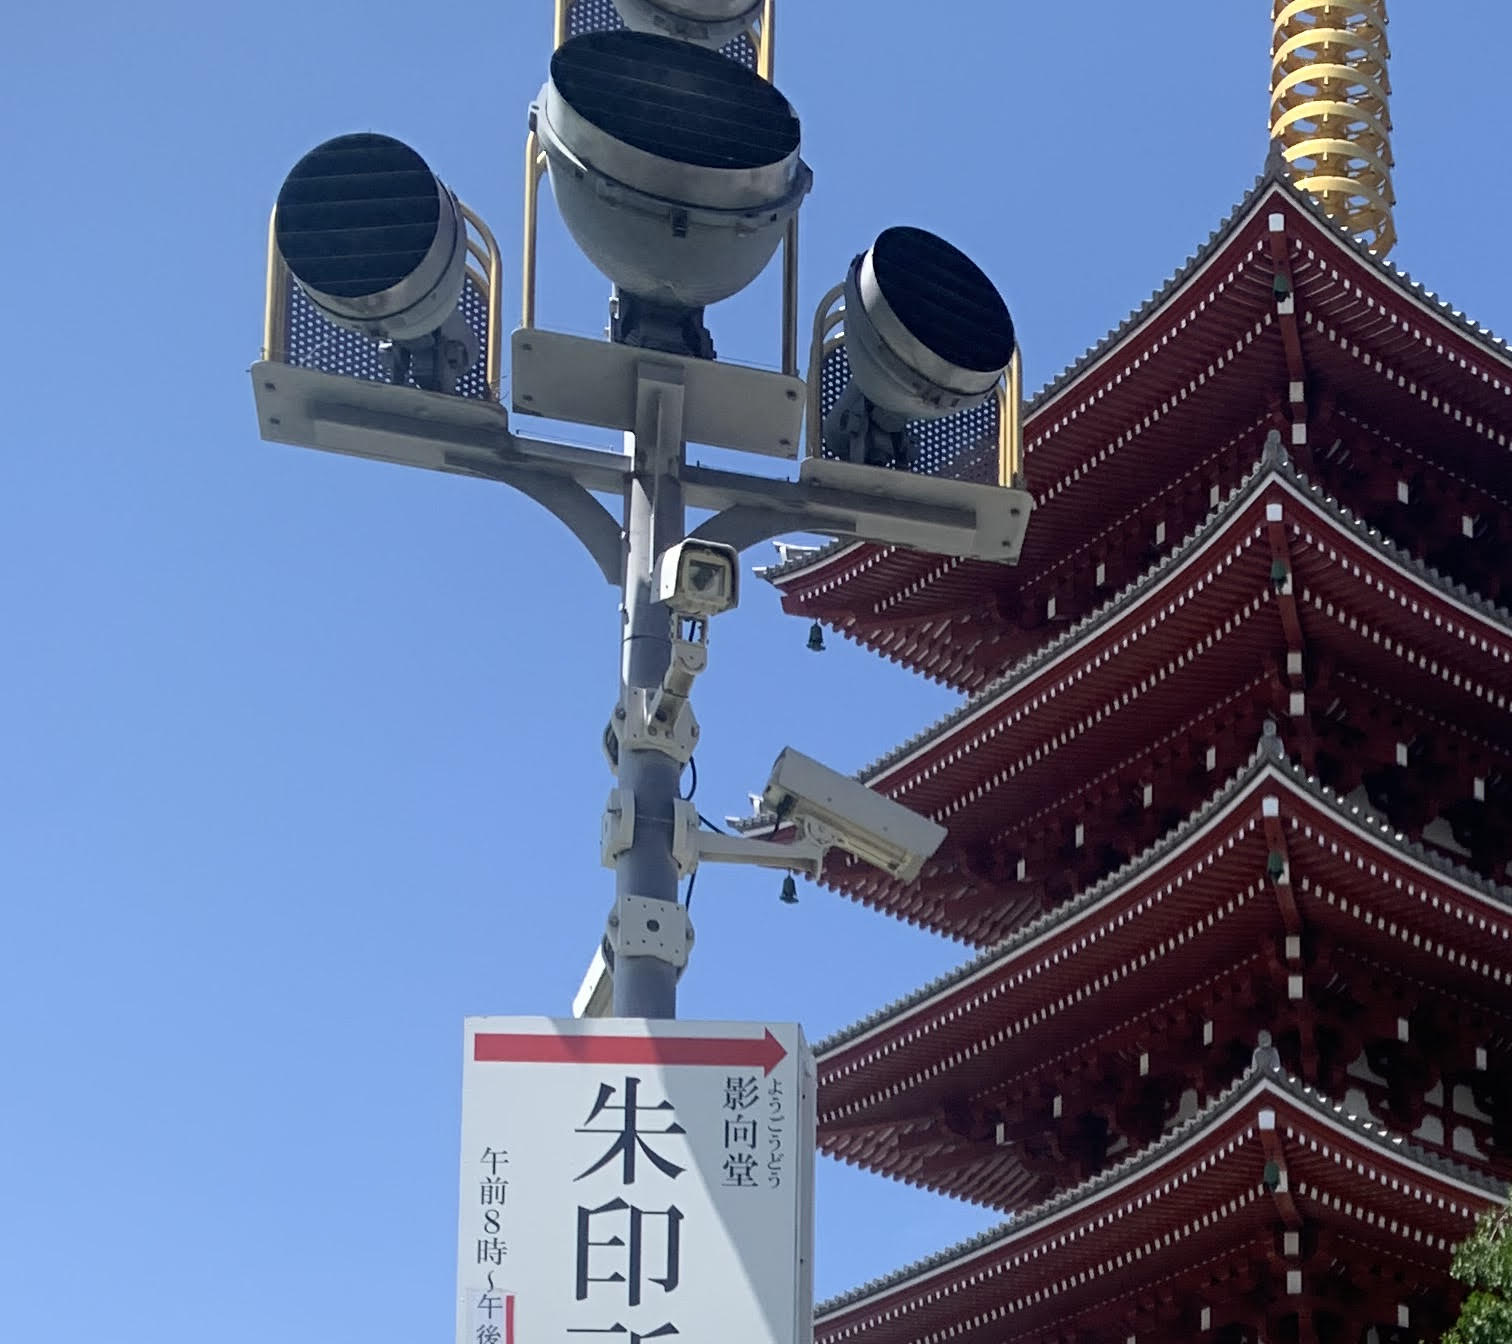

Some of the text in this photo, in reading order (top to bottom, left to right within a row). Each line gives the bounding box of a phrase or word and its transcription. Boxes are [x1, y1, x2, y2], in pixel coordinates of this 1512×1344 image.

[720, 1075, 760, 1188] 影向堂
[767, 1077, 785, 1189] ようごうどう
